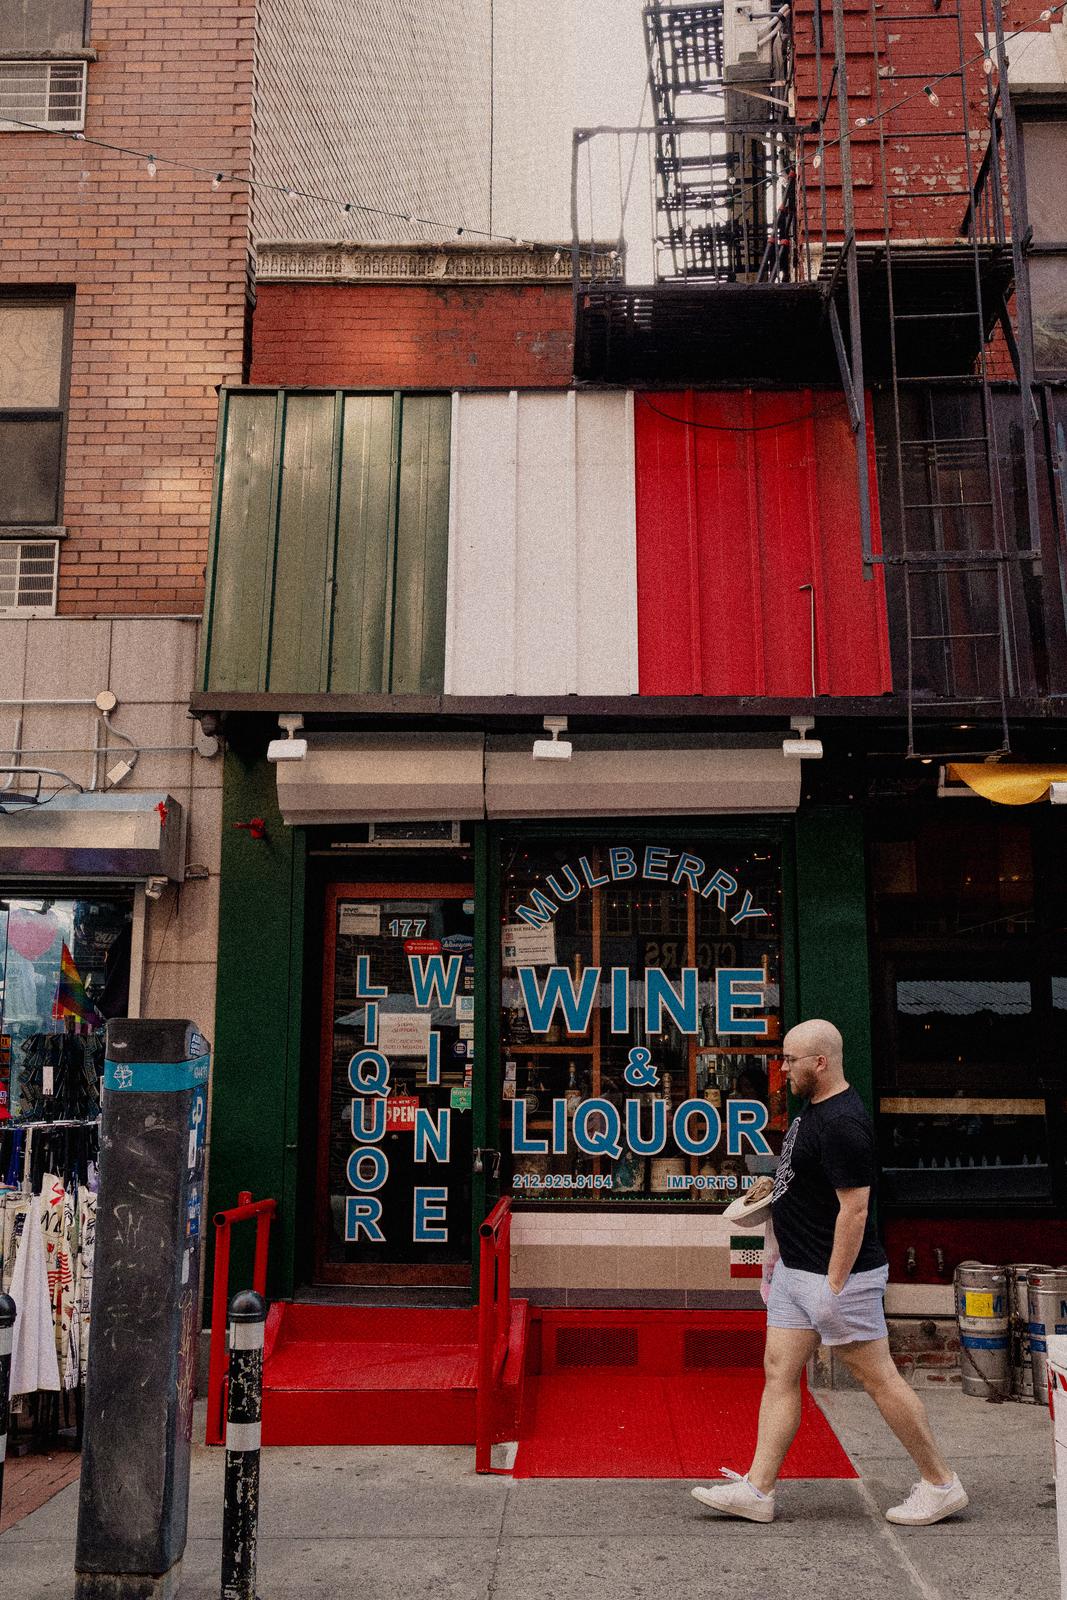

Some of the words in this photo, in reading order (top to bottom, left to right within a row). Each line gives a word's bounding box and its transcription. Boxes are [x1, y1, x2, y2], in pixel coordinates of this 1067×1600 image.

[515, 845, 768, 931] MULBERRY
[389, 918, 427, 938] 177
[516, 966, 769, 1035] WINE
[344, 955, 391, 1242] LIQUOR
[408, 955, 463, 1242] WINE
[624, 1046, 661, 1088] &
[511, 1097, 775, 1161] LIQUOR
[512, 1174, 614, 1190] 212.925.8154
[666, 1175, 737, 1191] IMPORTS
